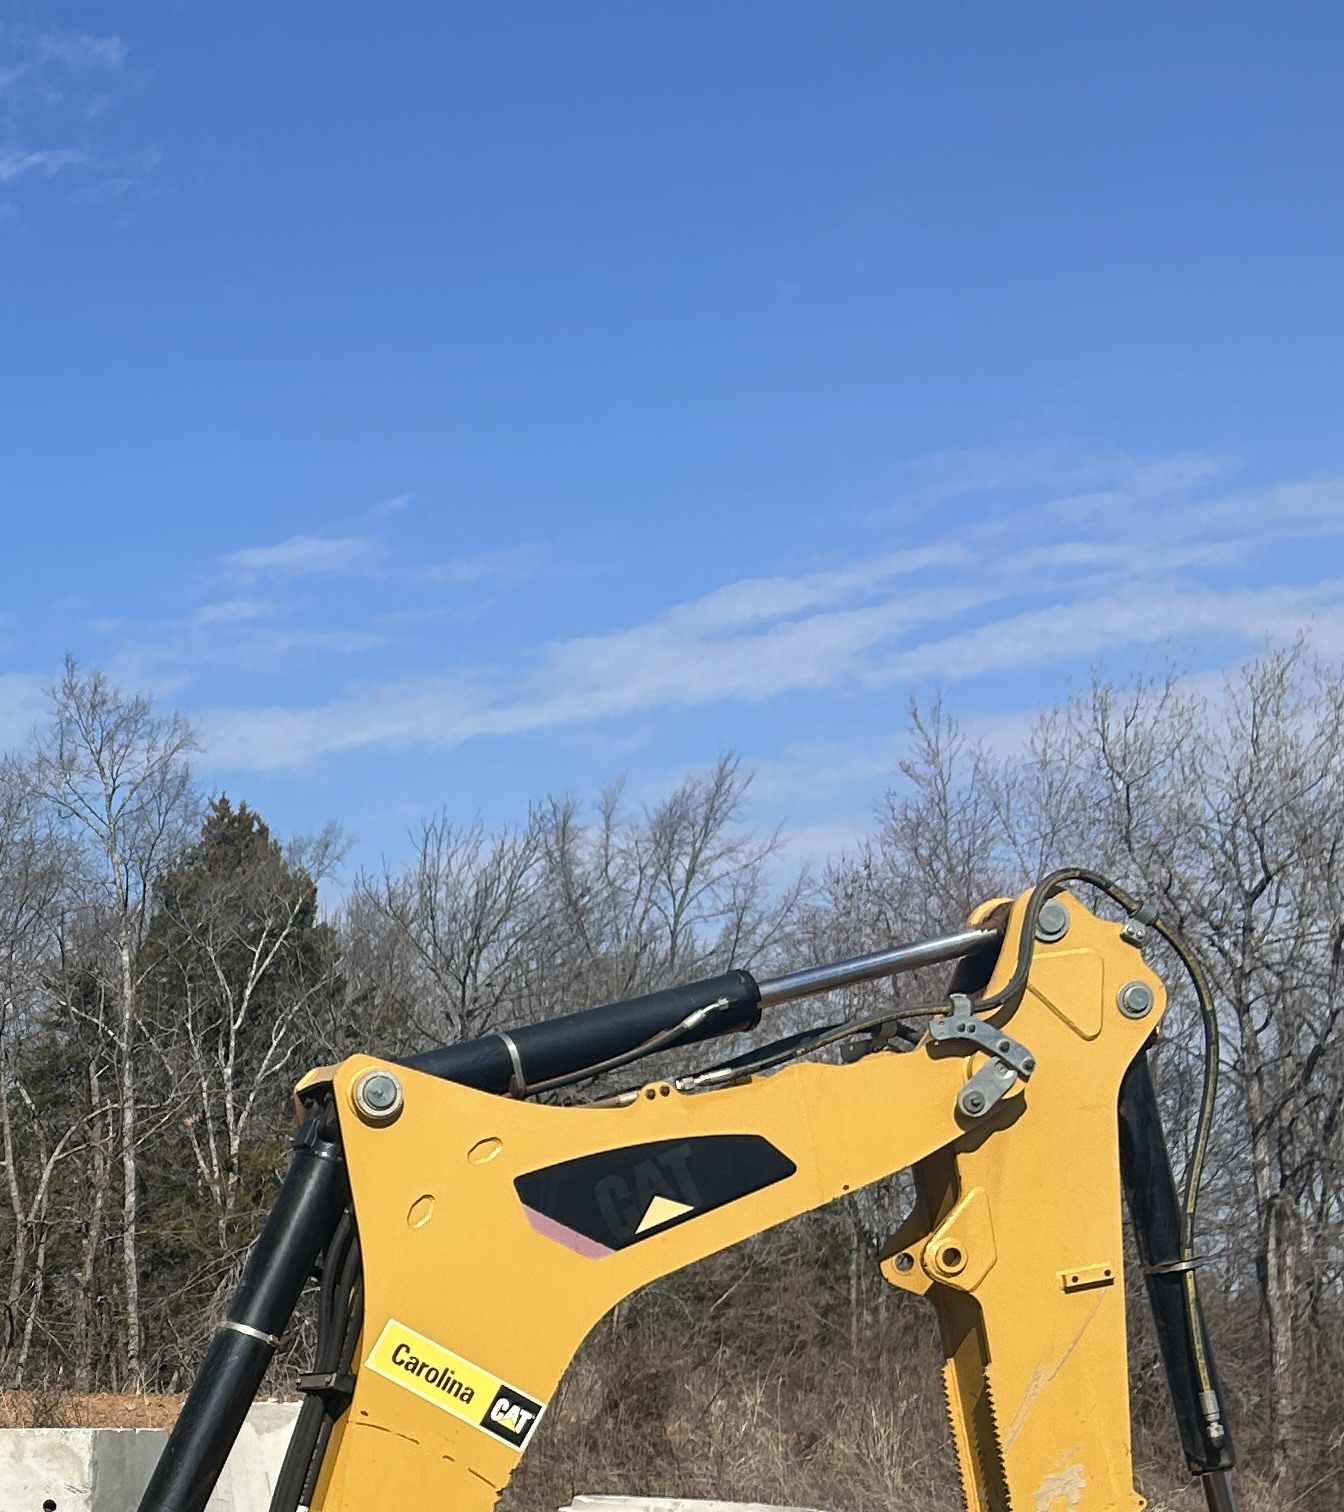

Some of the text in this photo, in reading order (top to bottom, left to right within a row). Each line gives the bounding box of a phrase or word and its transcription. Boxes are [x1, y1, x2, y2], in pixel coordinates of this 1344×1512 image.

[594, 1143, 703, 1241] CAT
[391, 1342, 534, 1435] Carolina CAT
